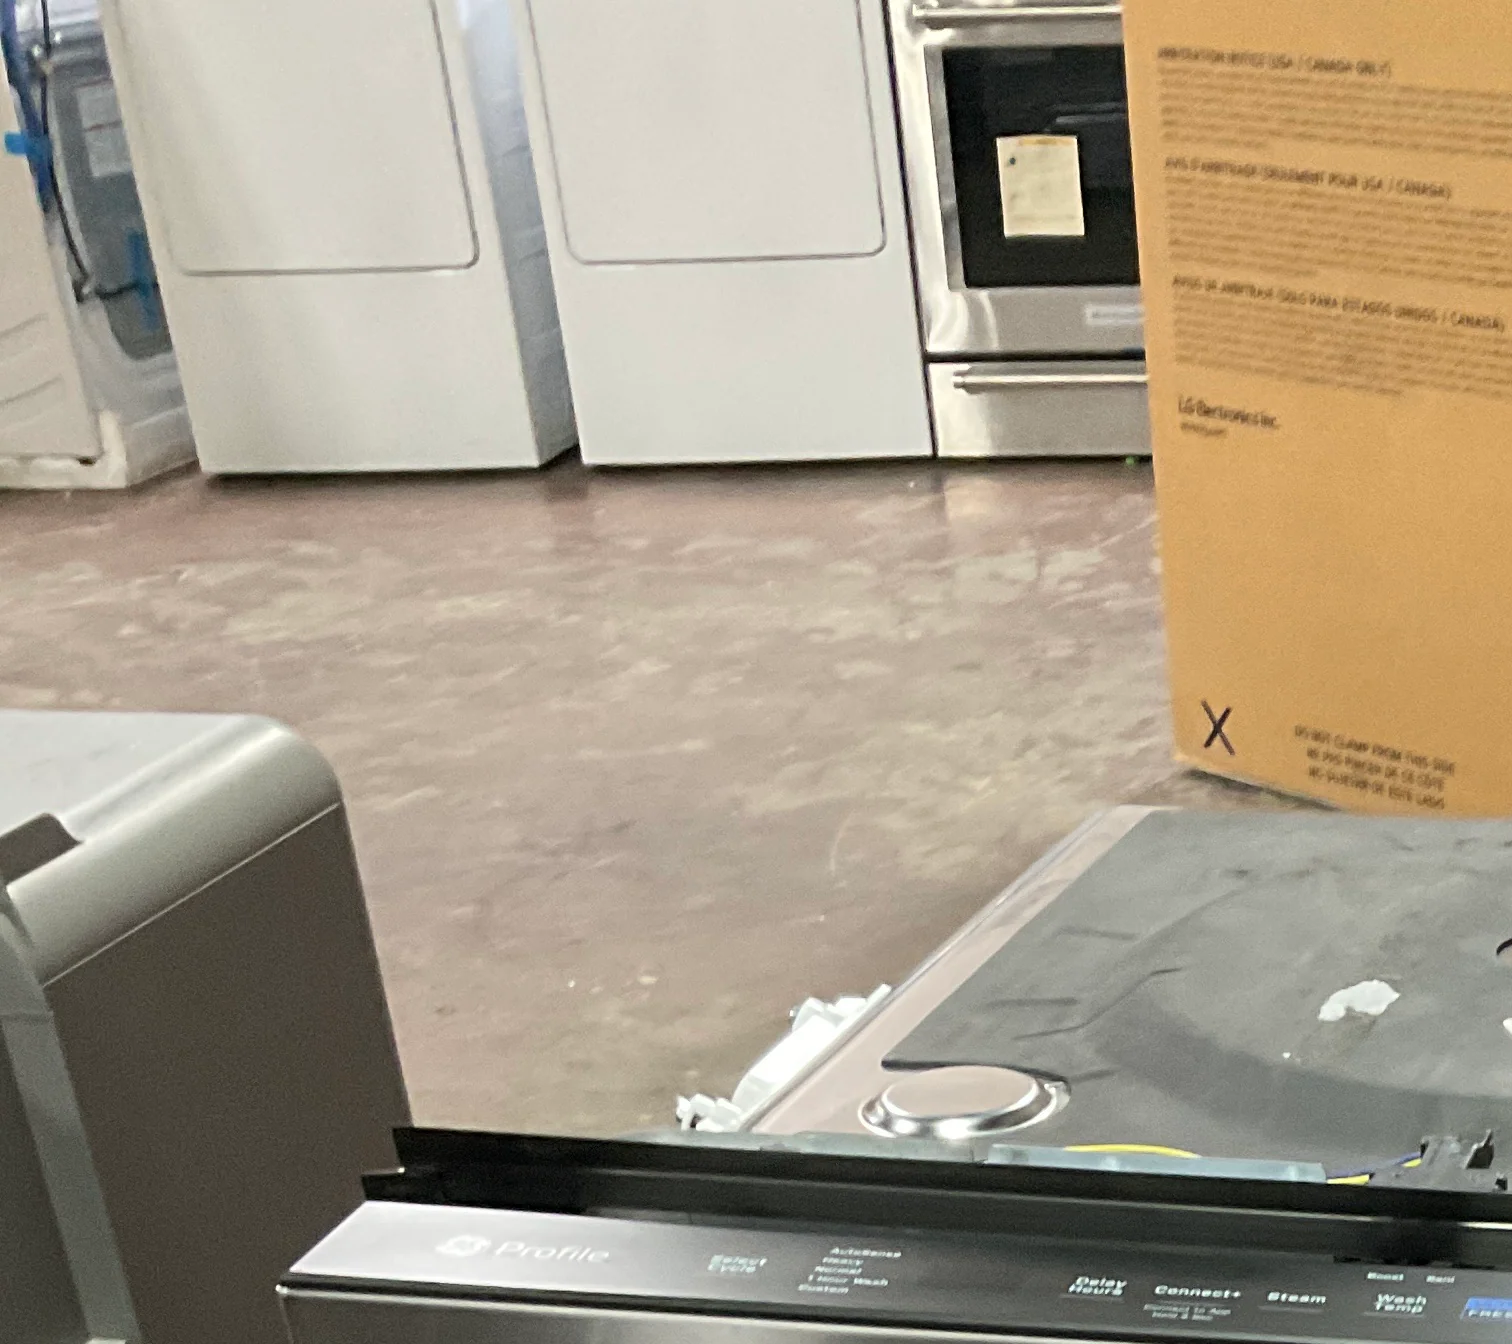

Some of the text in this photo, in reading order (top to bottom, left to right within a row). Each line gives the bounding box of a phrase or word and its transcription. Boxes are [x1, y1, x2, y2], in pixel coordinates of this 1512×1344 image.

[495, 1240, 611, 1264] Profile
[1074, 1276, 1128, 1289] Delay
[1068, 1284, 1125, 1297] Hours
[1267, 1291, 1327, 1305] Steam
[1377, 1293, 1428, 1307] Wash
[1375, 1300, 1424, 1315] Temp
